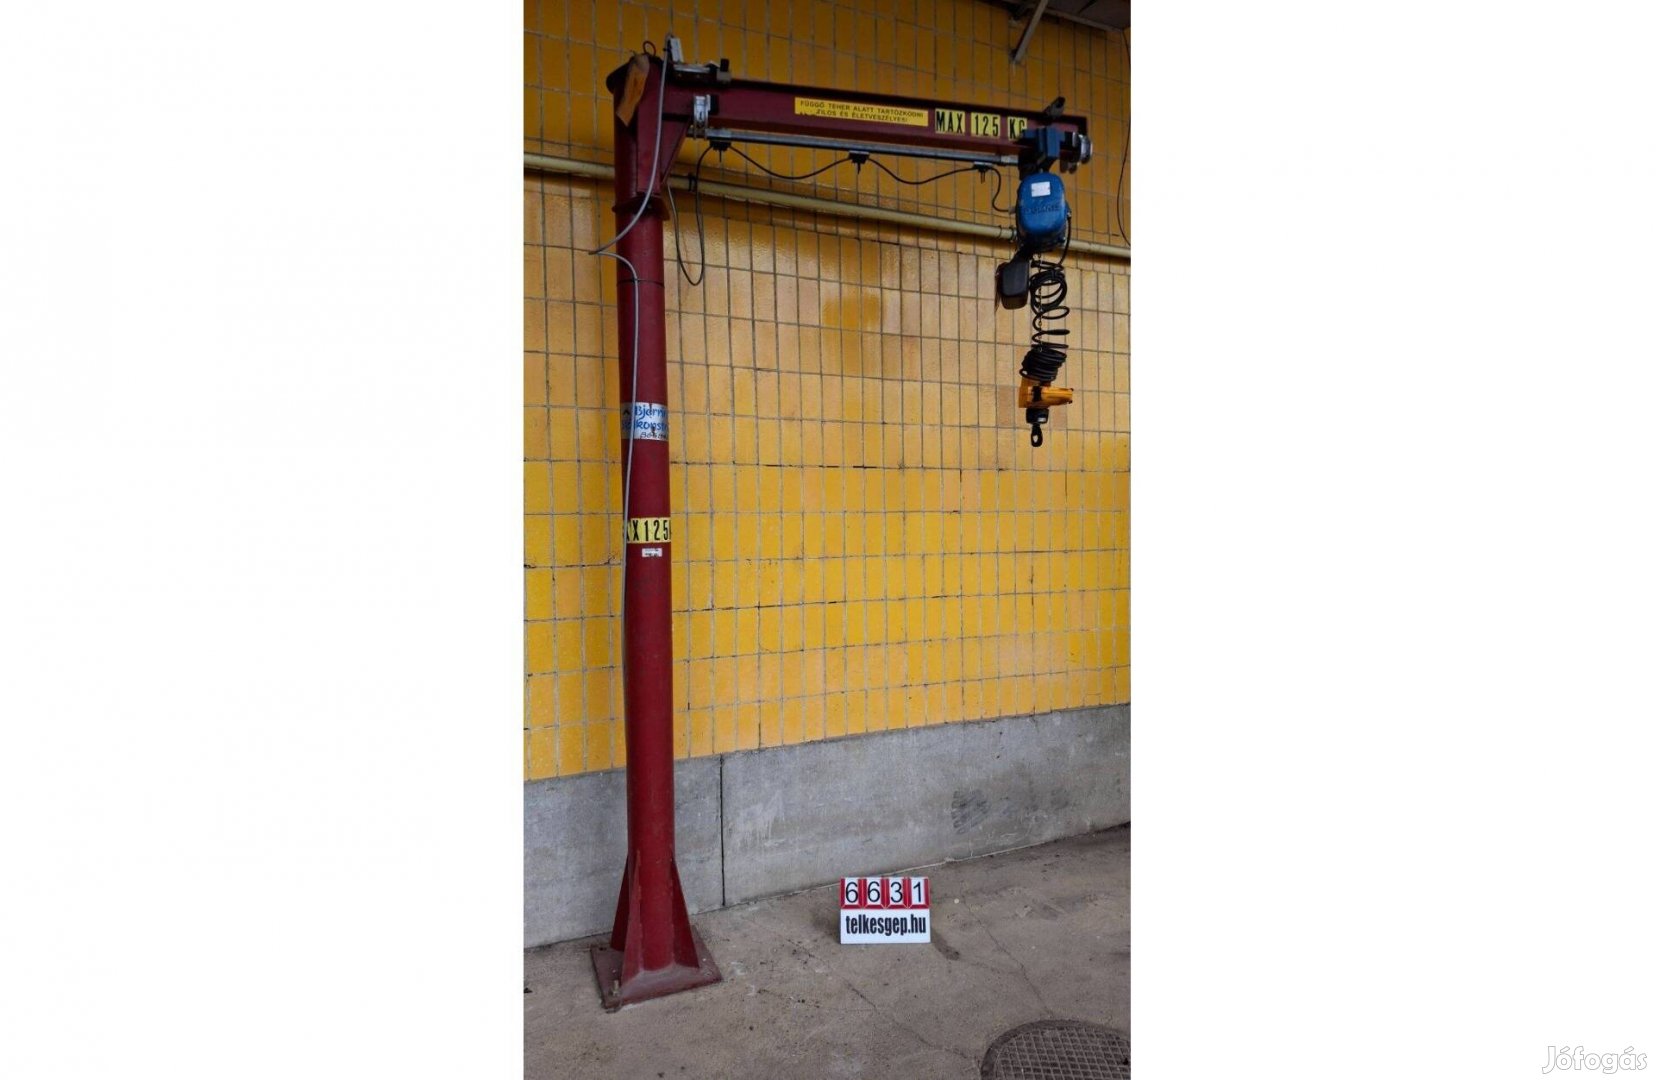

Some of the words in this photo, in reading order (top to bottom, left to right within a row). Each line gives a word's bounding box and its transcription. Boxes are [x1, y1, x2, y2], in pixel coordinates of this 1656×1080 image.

[828, 103, 850, 111] TEHER
[853, 105, 874, 113] ALATT
[936, 111, 963, 133] MAX
[974, 114, 999, 136] 125
[845, 881, 922, 903] 6631
[845, 913, 926, 937] telkesgep.hu
